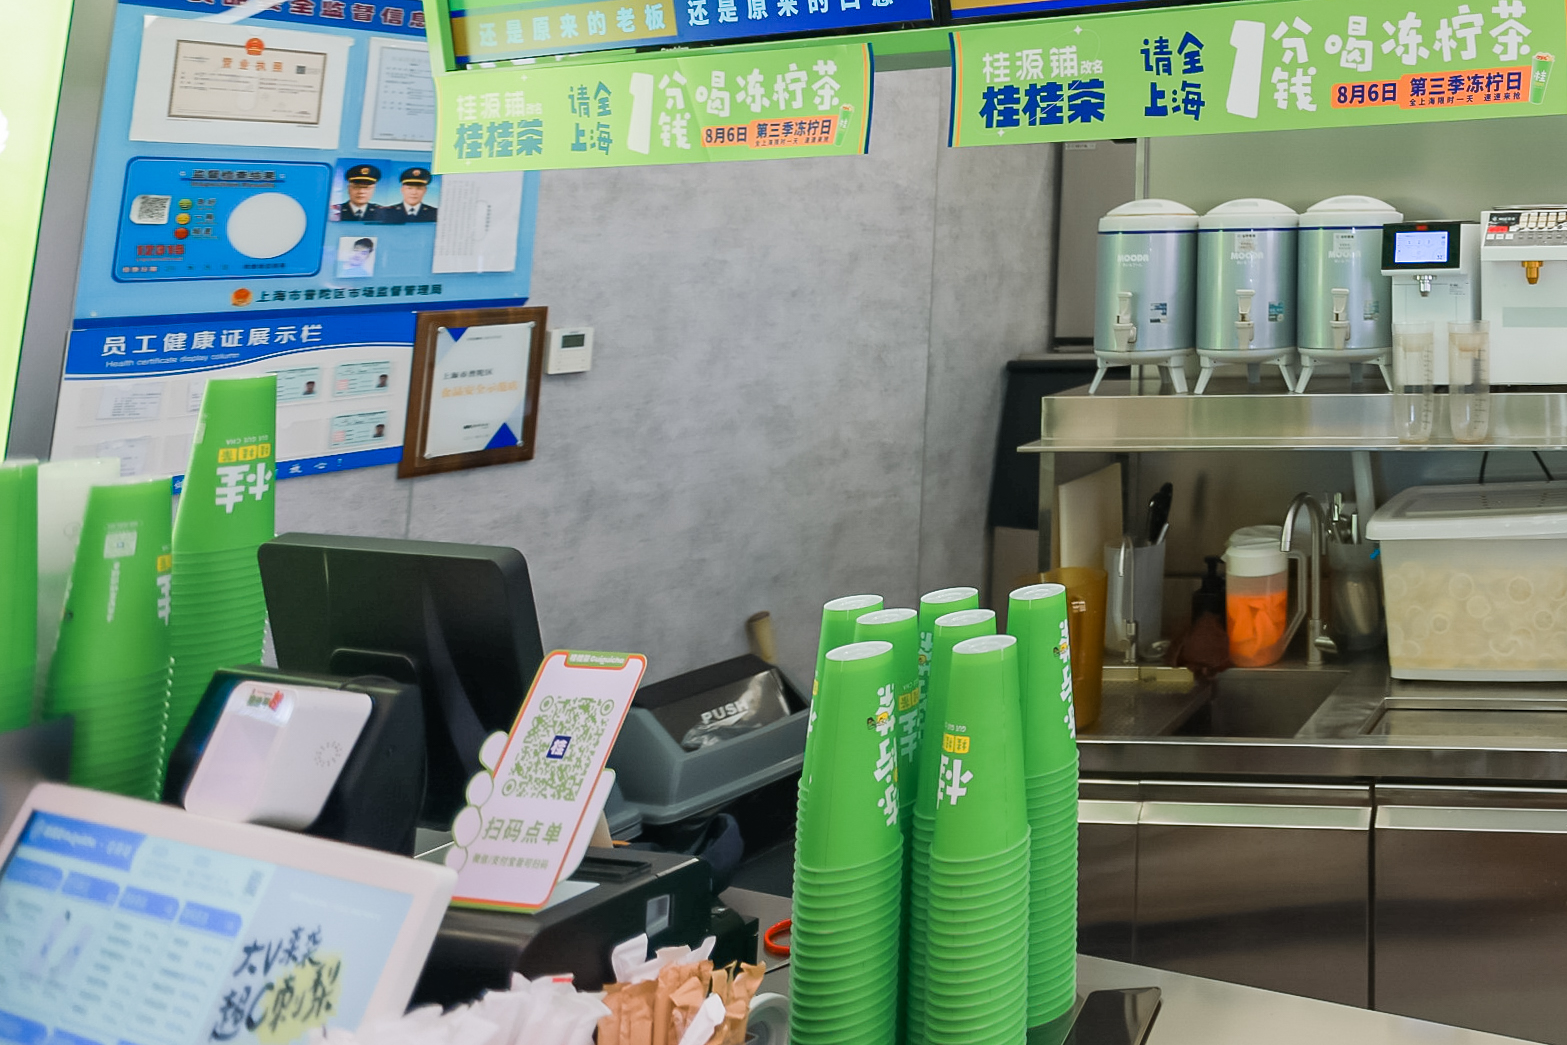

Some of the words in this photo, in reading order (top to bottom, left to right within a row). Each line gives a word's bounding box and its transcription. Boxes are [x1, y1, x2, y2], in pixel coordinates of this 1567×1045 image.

[479, 3, 666, 47] 还是原来的老板
[1323, 0, 1532, 66] 喝冻柠茶
[1140, 30, 1206, 77] 请全
[568, 81, 612, 118] 请全
[695, 59, 841, 118] 喝冻柠茶
[1143, 80, 1206, 122] 上海
[1337, 82, 1397, 106] 8月6日
[1410, 71, 1522, 97] 第三季冻柠日
[979, 78, 1106, 129] 桂桂茶
[454, 119, 543, 159] 桂桂茶
[571, 122, 613, 156] 上海
[705, 127, 748, 144] 8月6日
[755, 119, 832, 139] 第三季冻柠日
[101, 324, 322, 356] 员工健康证展示栏
[482, 817, 562, 844] 扫码点单
